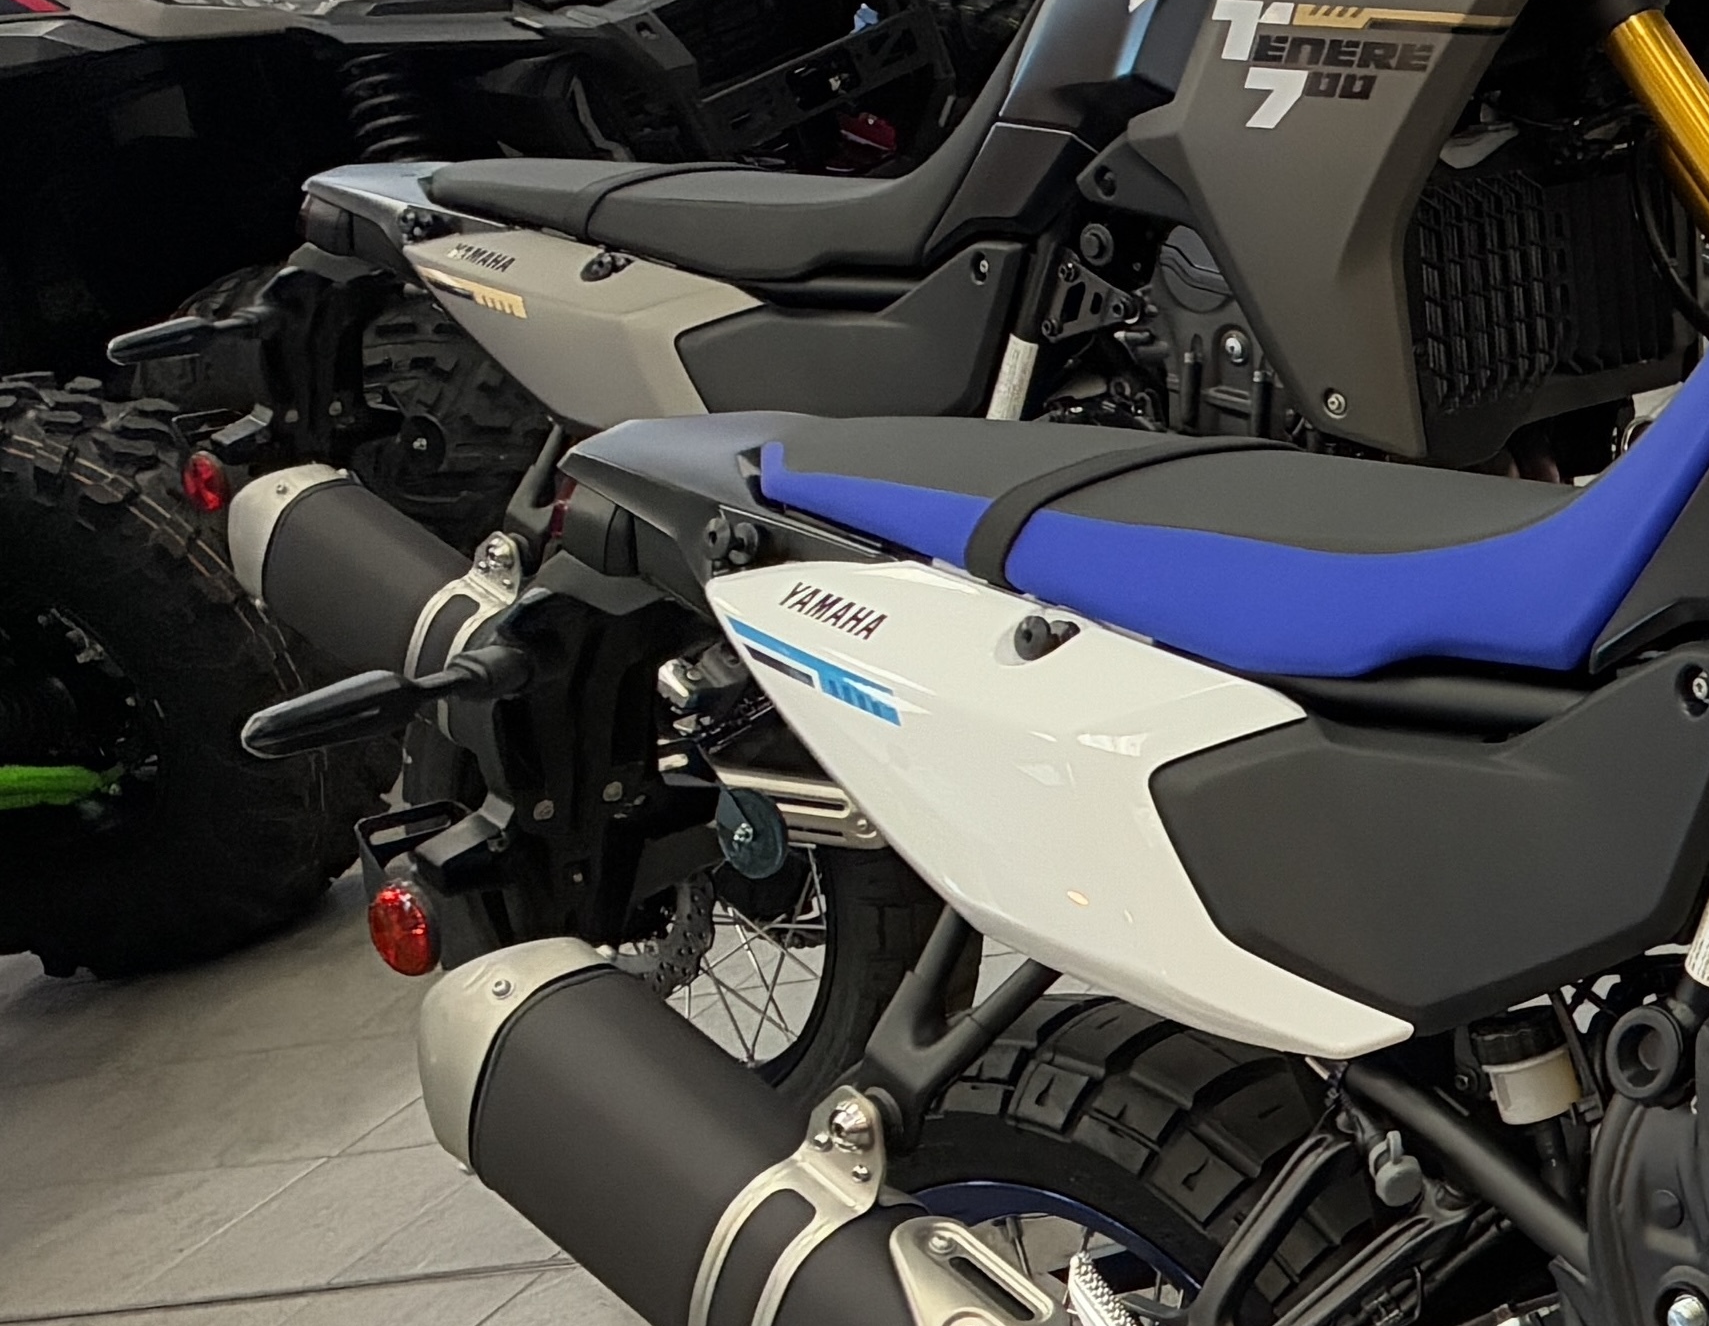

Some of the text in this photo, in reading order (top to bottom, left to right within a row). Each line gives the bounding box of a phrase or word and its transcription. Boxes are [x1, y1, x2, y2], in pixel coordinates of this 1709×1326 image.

[1212, 0, 1435, 72] TENERE
[1243, 69, 1375, 129] 700
[452, 242, 515, 274] YAMAHA
[778, 582, 888, 642] YAMAHA
